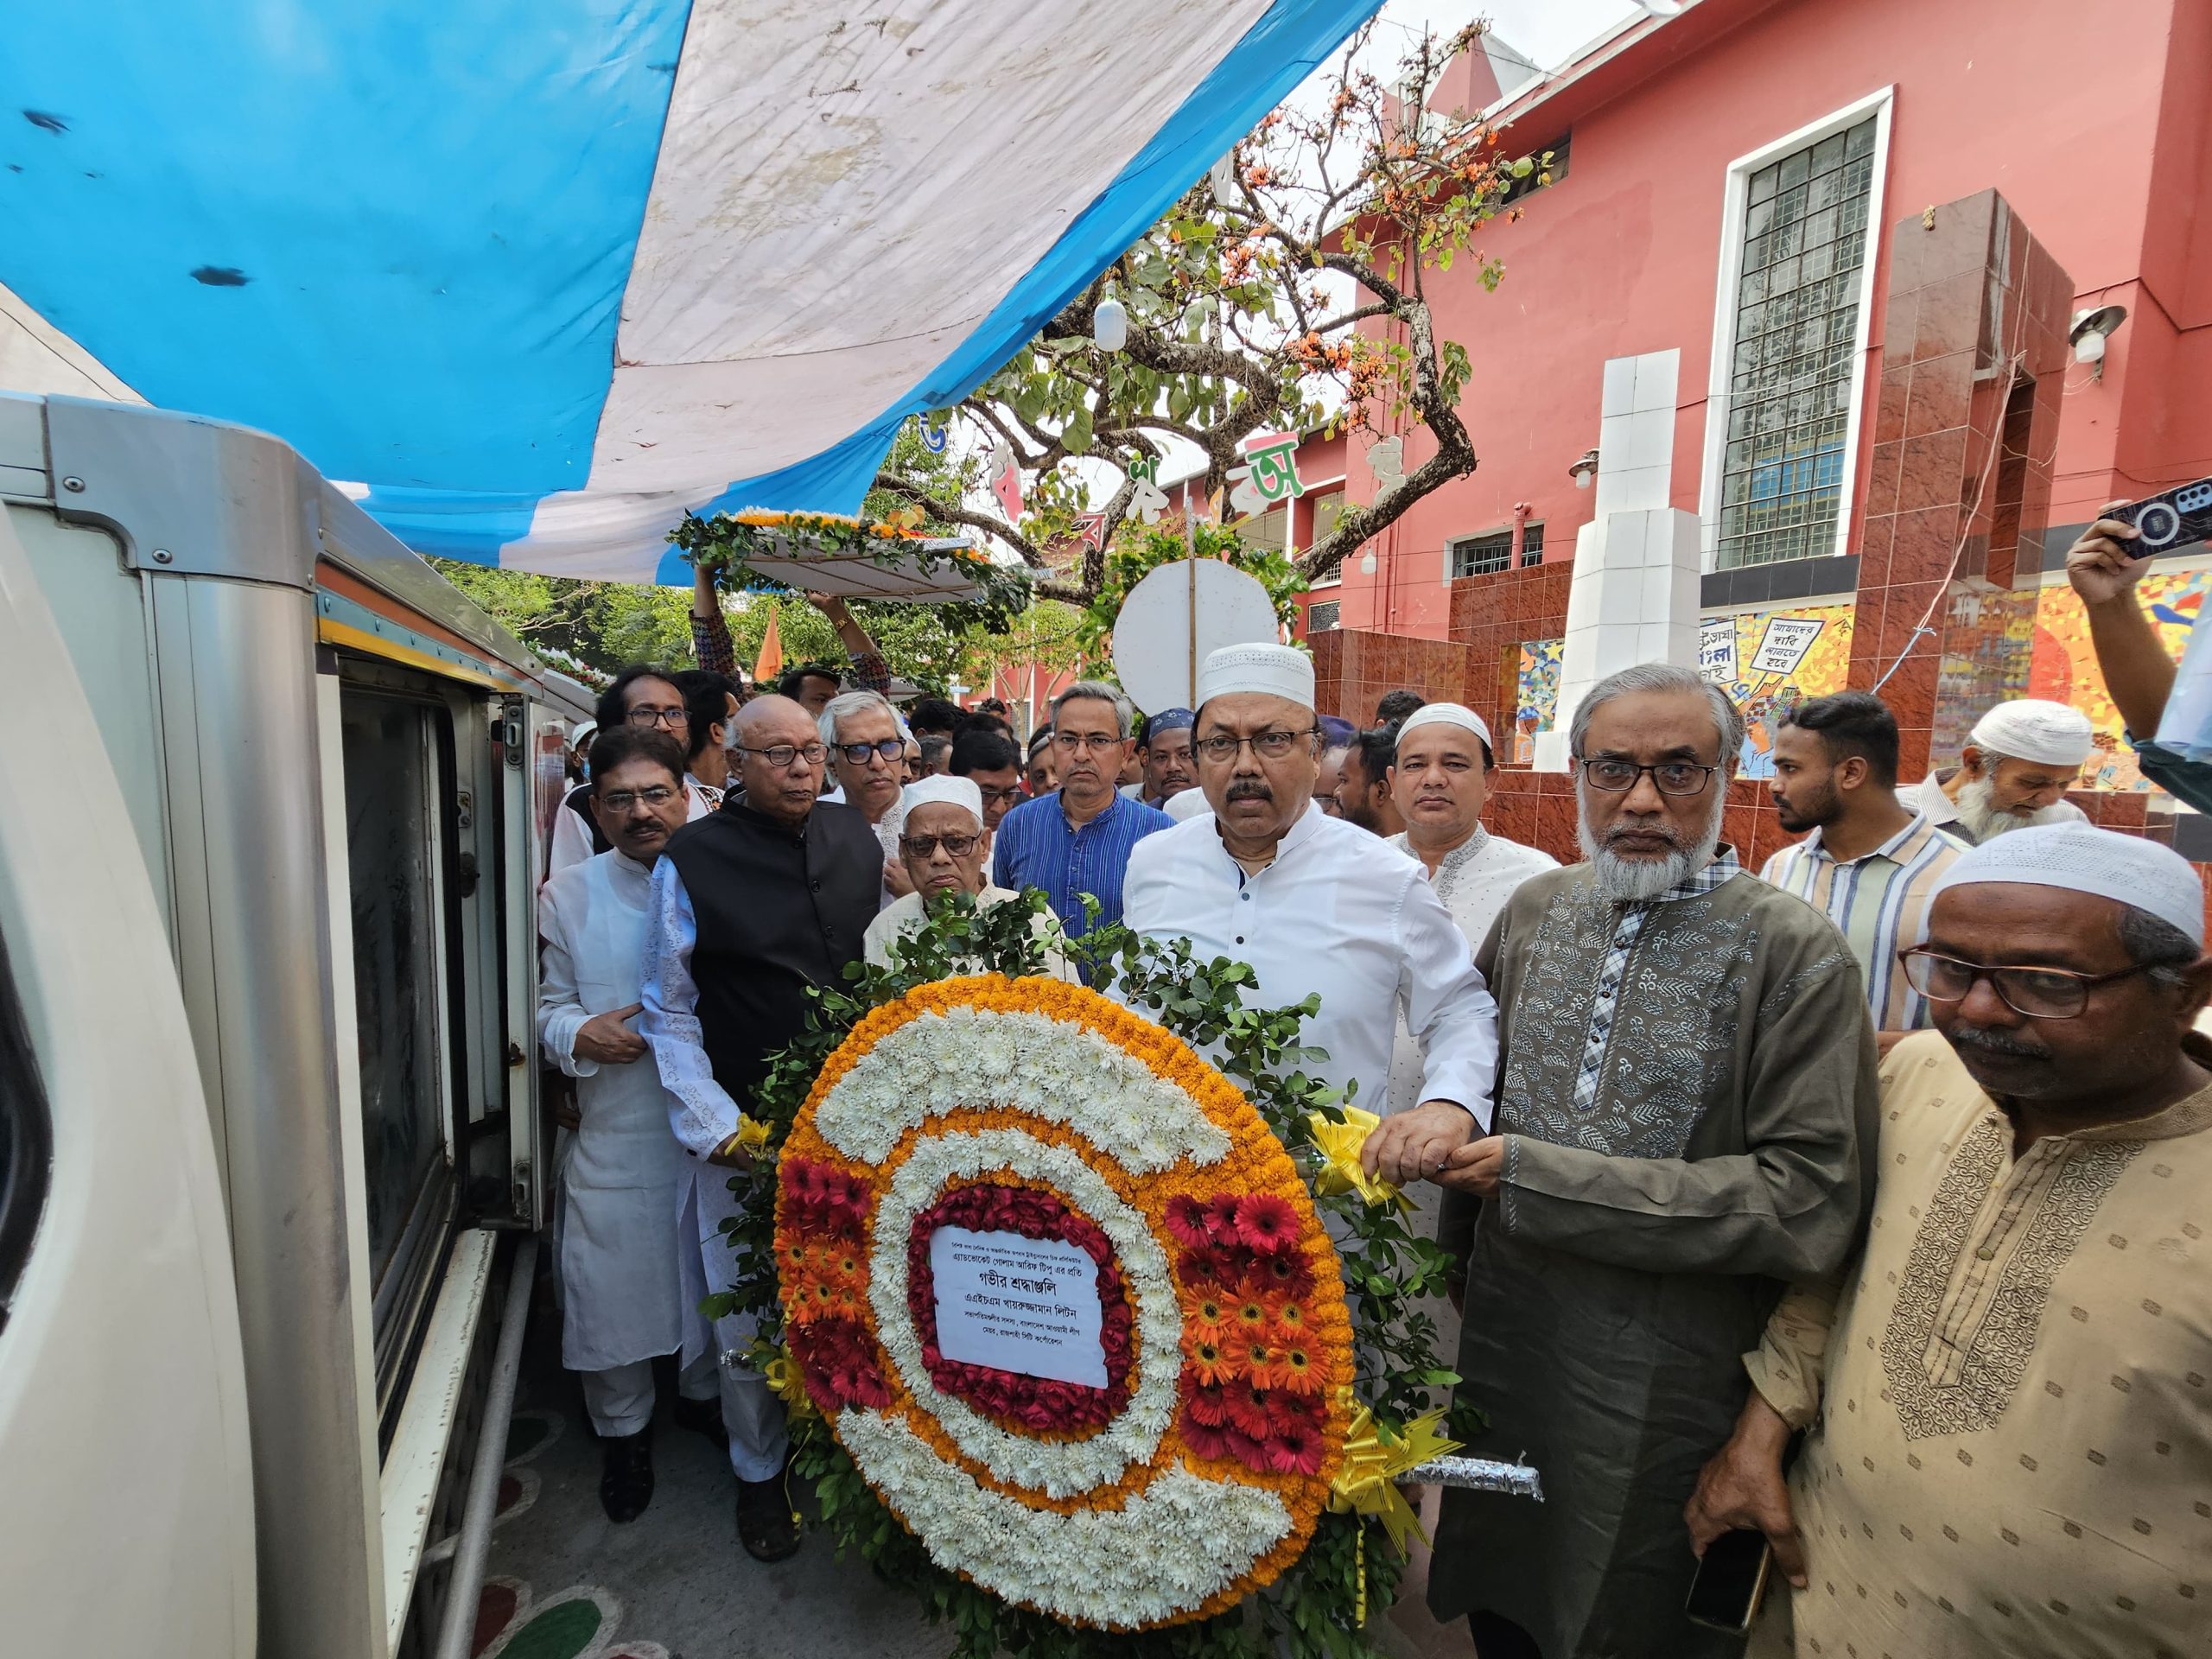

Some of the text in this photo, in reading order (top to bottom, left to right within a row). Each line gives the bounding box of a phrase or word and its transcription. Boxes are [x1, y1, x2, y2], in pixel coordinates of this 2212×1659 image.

[1774, 635, 1799, 646] দাবি
[1767, 658, 1788, 669] হবে
[993, 1258, 1014, 1268] গোলাম
[1016, 1260, 1038, 1271] আরিফ
[1039, 1262, 1052, 1275] টিপু
[1055, 1267, 1065, 1275] এর
[1067, 1266, 1083, 1277] প্রতি
[979, 1269, 1057, 1296] গভীর শ্রদ্ধাঞ্জলি
[964, 1294, 1077, 1319] এএইচএম খায়রুজ্জামান লিটন
[1020, 1320, 1045, 1331] বাংলাদেশ
[1046, 1325, 1068, 1334] আওয়ামী
[1069, 1326, 1080, 1337] লীগ
[1021, 1332, 1033, 1341] সিটি
